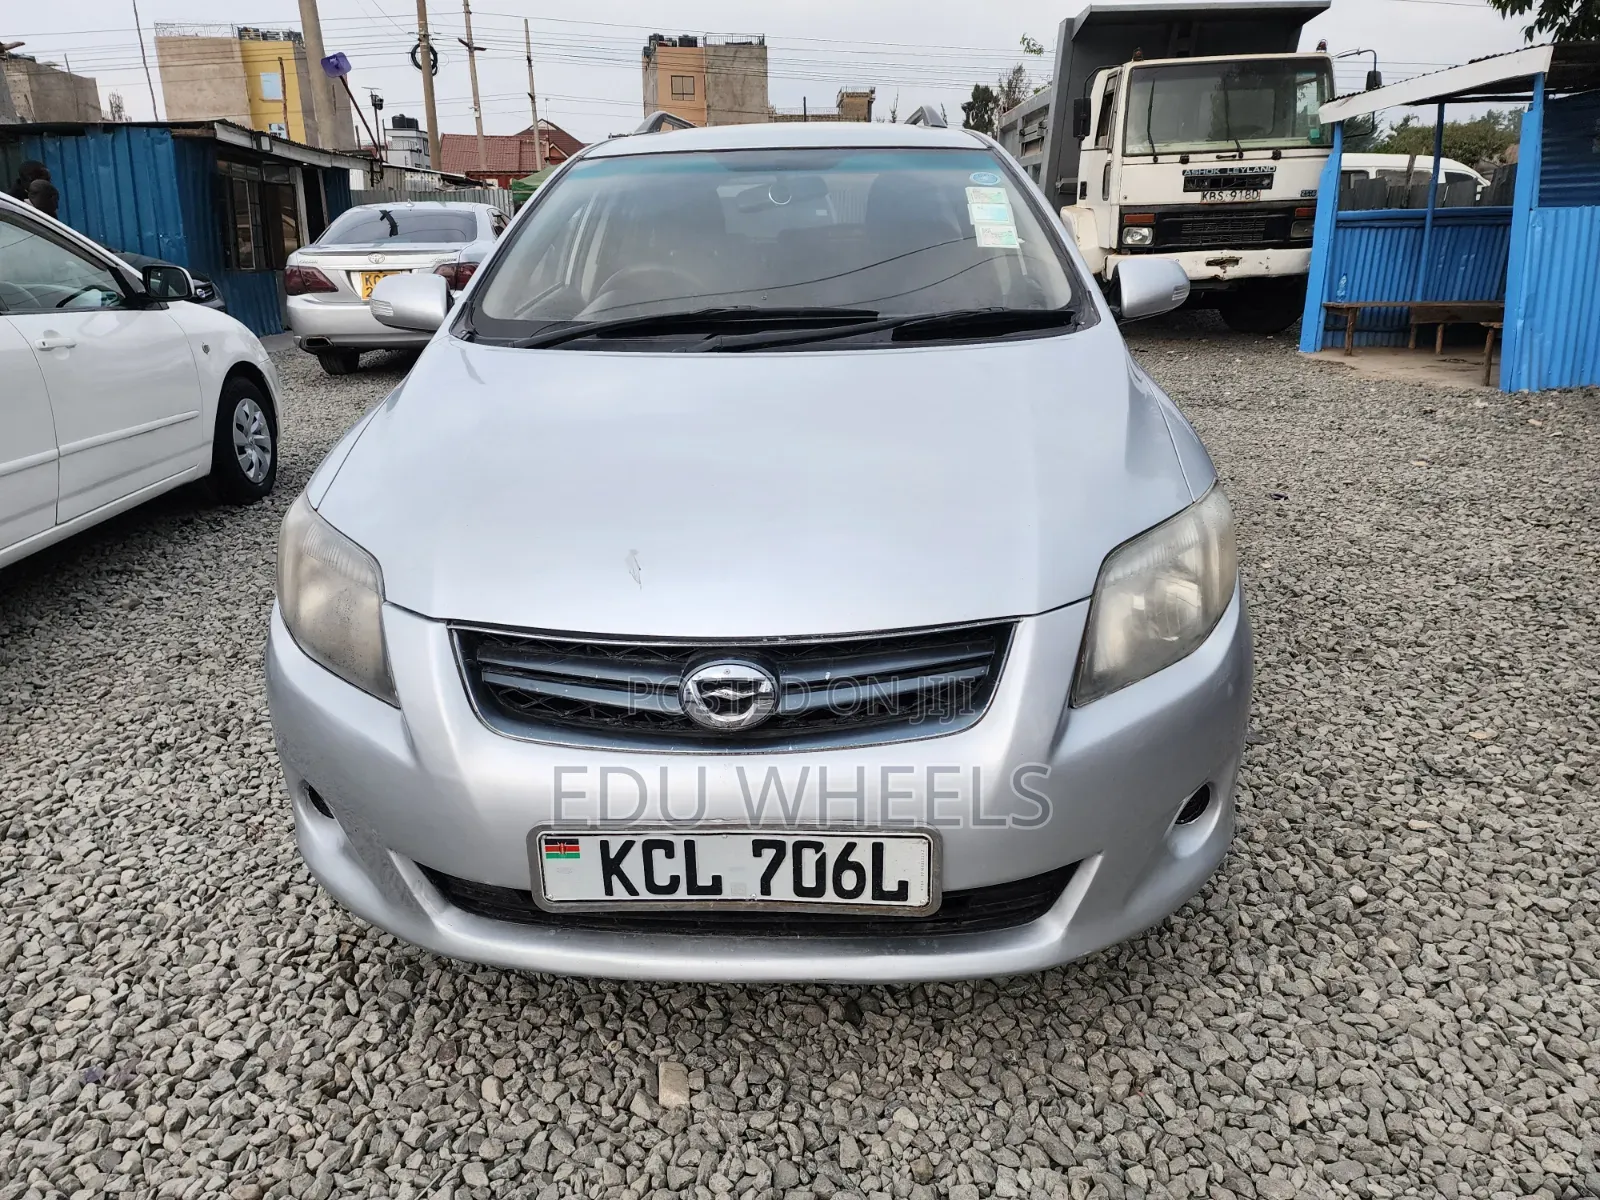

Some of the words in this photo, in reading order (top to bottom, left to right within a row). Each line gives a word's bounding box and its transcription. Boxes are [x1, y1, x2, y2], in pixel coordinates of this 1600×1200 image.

[1184, 168, 1220, 176] ASHOK
[1227, 166, 1276, 174] LEYLAND
[1202, 191, 1224, 201] KBS
[1230, 189, 1259, 201] 918D
[600, 839, 722, 896] KCL
[752, 839, 909, 901] 706L
